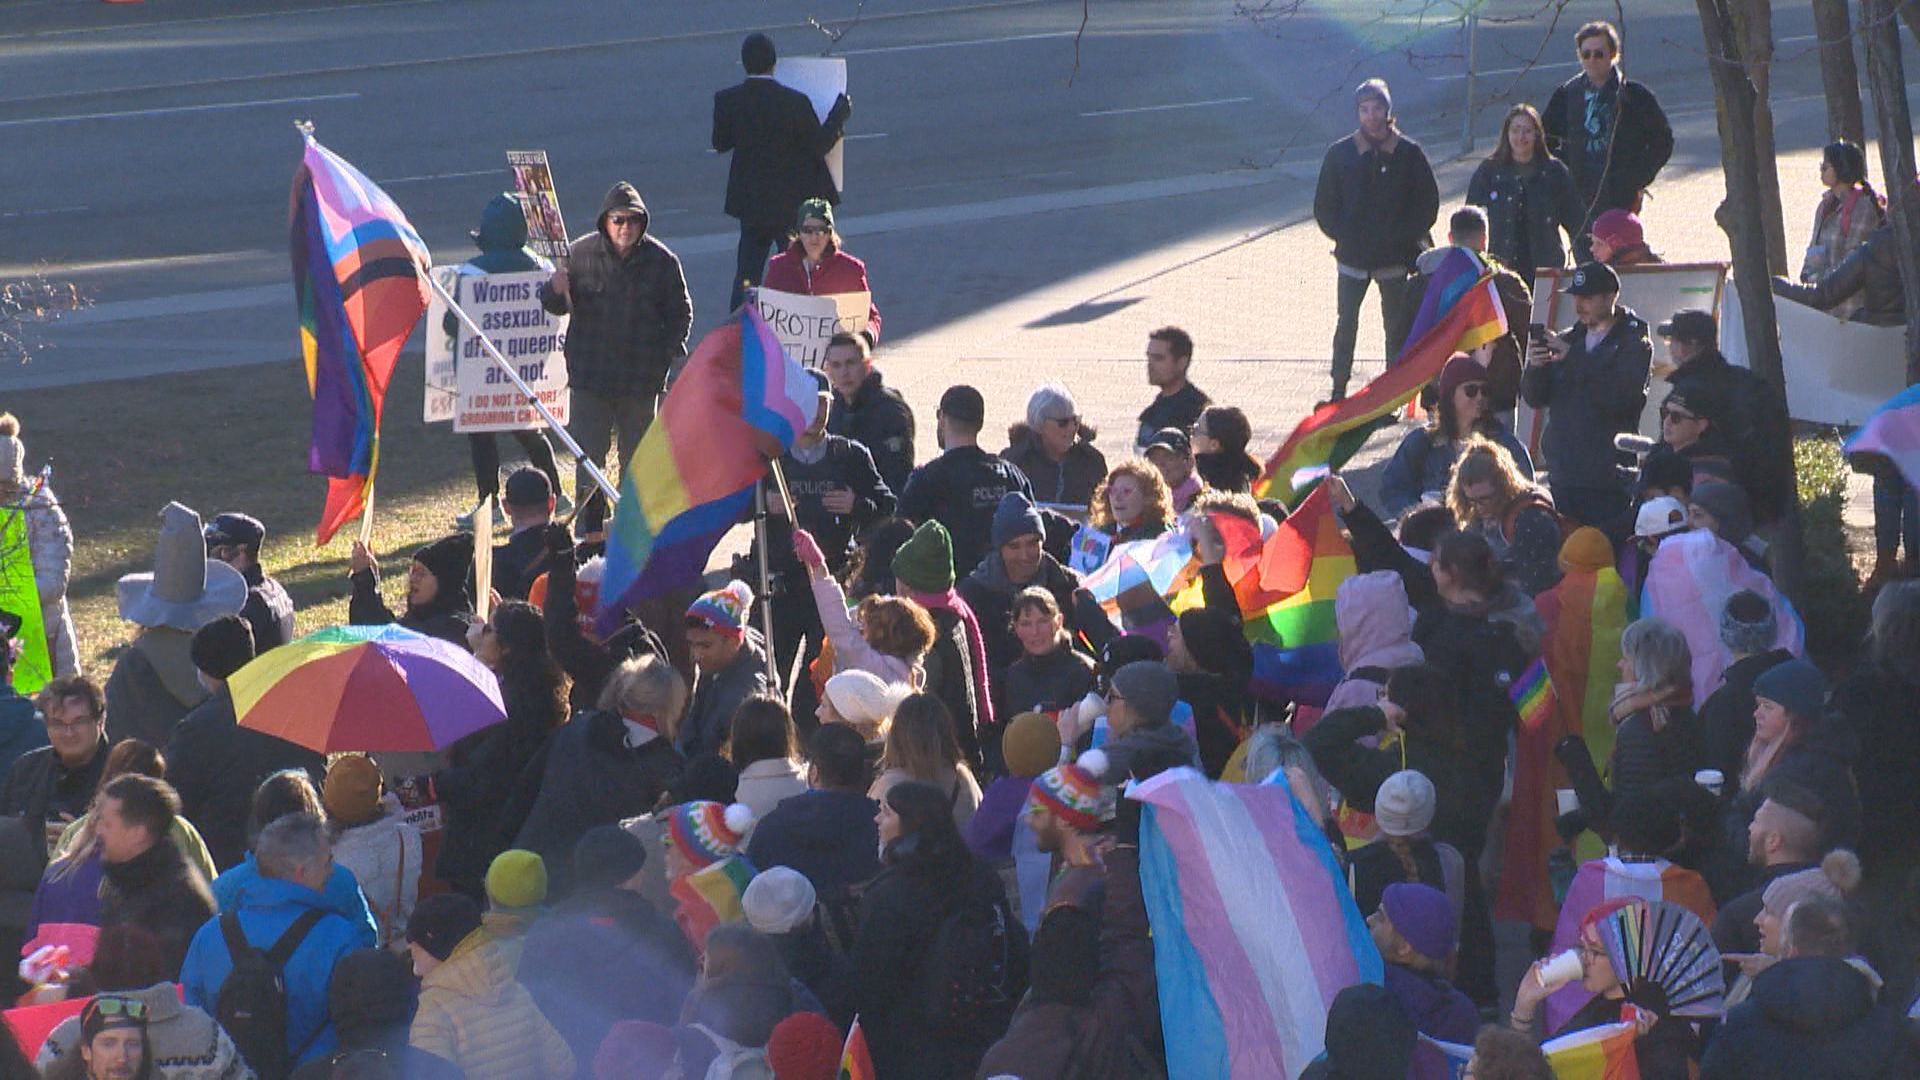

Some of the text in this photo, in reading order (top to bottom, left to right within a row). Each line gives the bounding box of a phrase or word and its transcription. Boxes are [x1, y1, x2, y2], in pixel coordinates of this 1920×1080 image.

[473, 281, 530, 304] Worms
[482, 308, 550, 331] asexual,
[464, 334, 566, 358] drg queens
[519, 359, 548, 383] not.
[475, 394, 489, 408] DO
[492, 393, 512, 407] NOT
